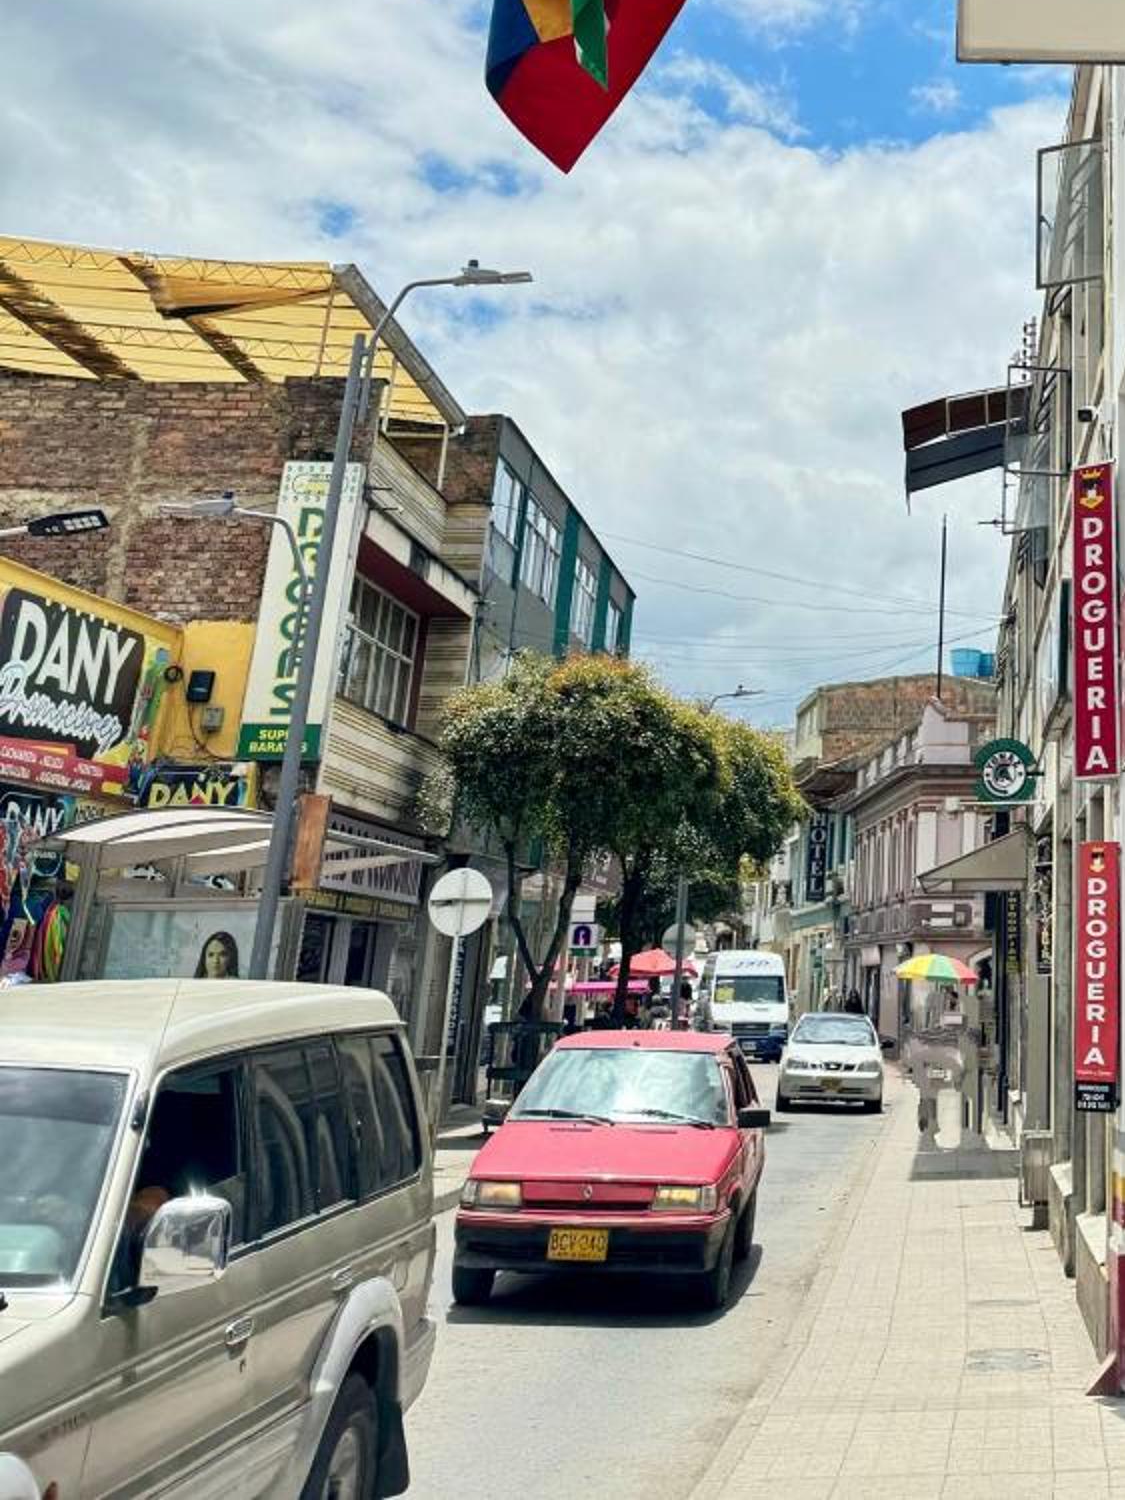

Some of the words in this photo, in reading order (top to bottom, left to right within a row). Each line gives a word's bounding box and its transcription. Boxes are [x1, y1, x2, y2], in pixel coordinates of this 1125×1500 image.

[10, 600, 137, 705] DANY
[1081, 516, 1109, 771] DROGUERIA
[147, 782, 236, 808] DANY
[810, 812, 828, 893] HOTEL
[1083, 877, 1108, 1066] DROGUERIA
